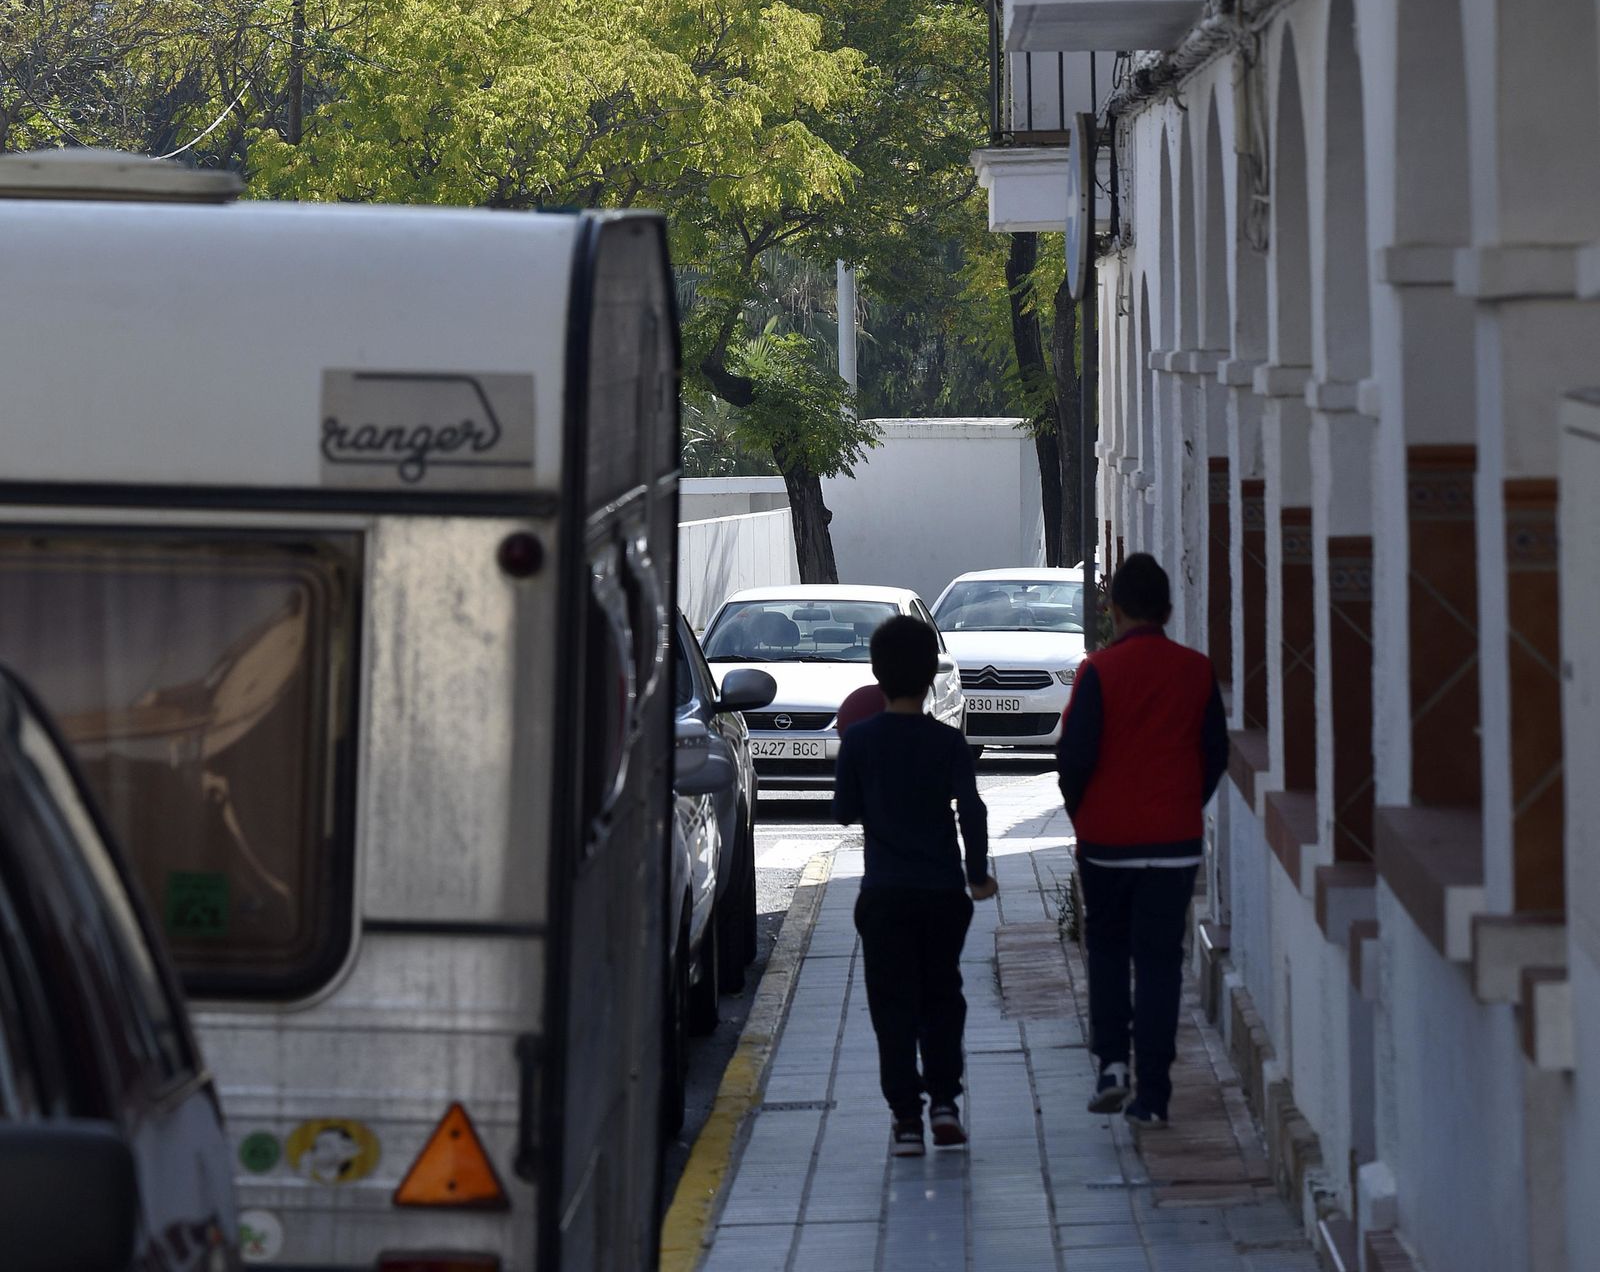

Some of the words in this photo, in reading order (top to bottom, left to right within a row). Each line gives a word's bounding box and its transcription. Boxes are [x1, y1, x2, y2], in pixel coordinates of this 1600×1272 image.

[321, 417, 498, 483] ranger
[965, 698, 992, 711] 830
[996, 698, 1020, 711] HSD
[752, 742, 786, 756] 3427
[792, 742, 819, 756] BGC
